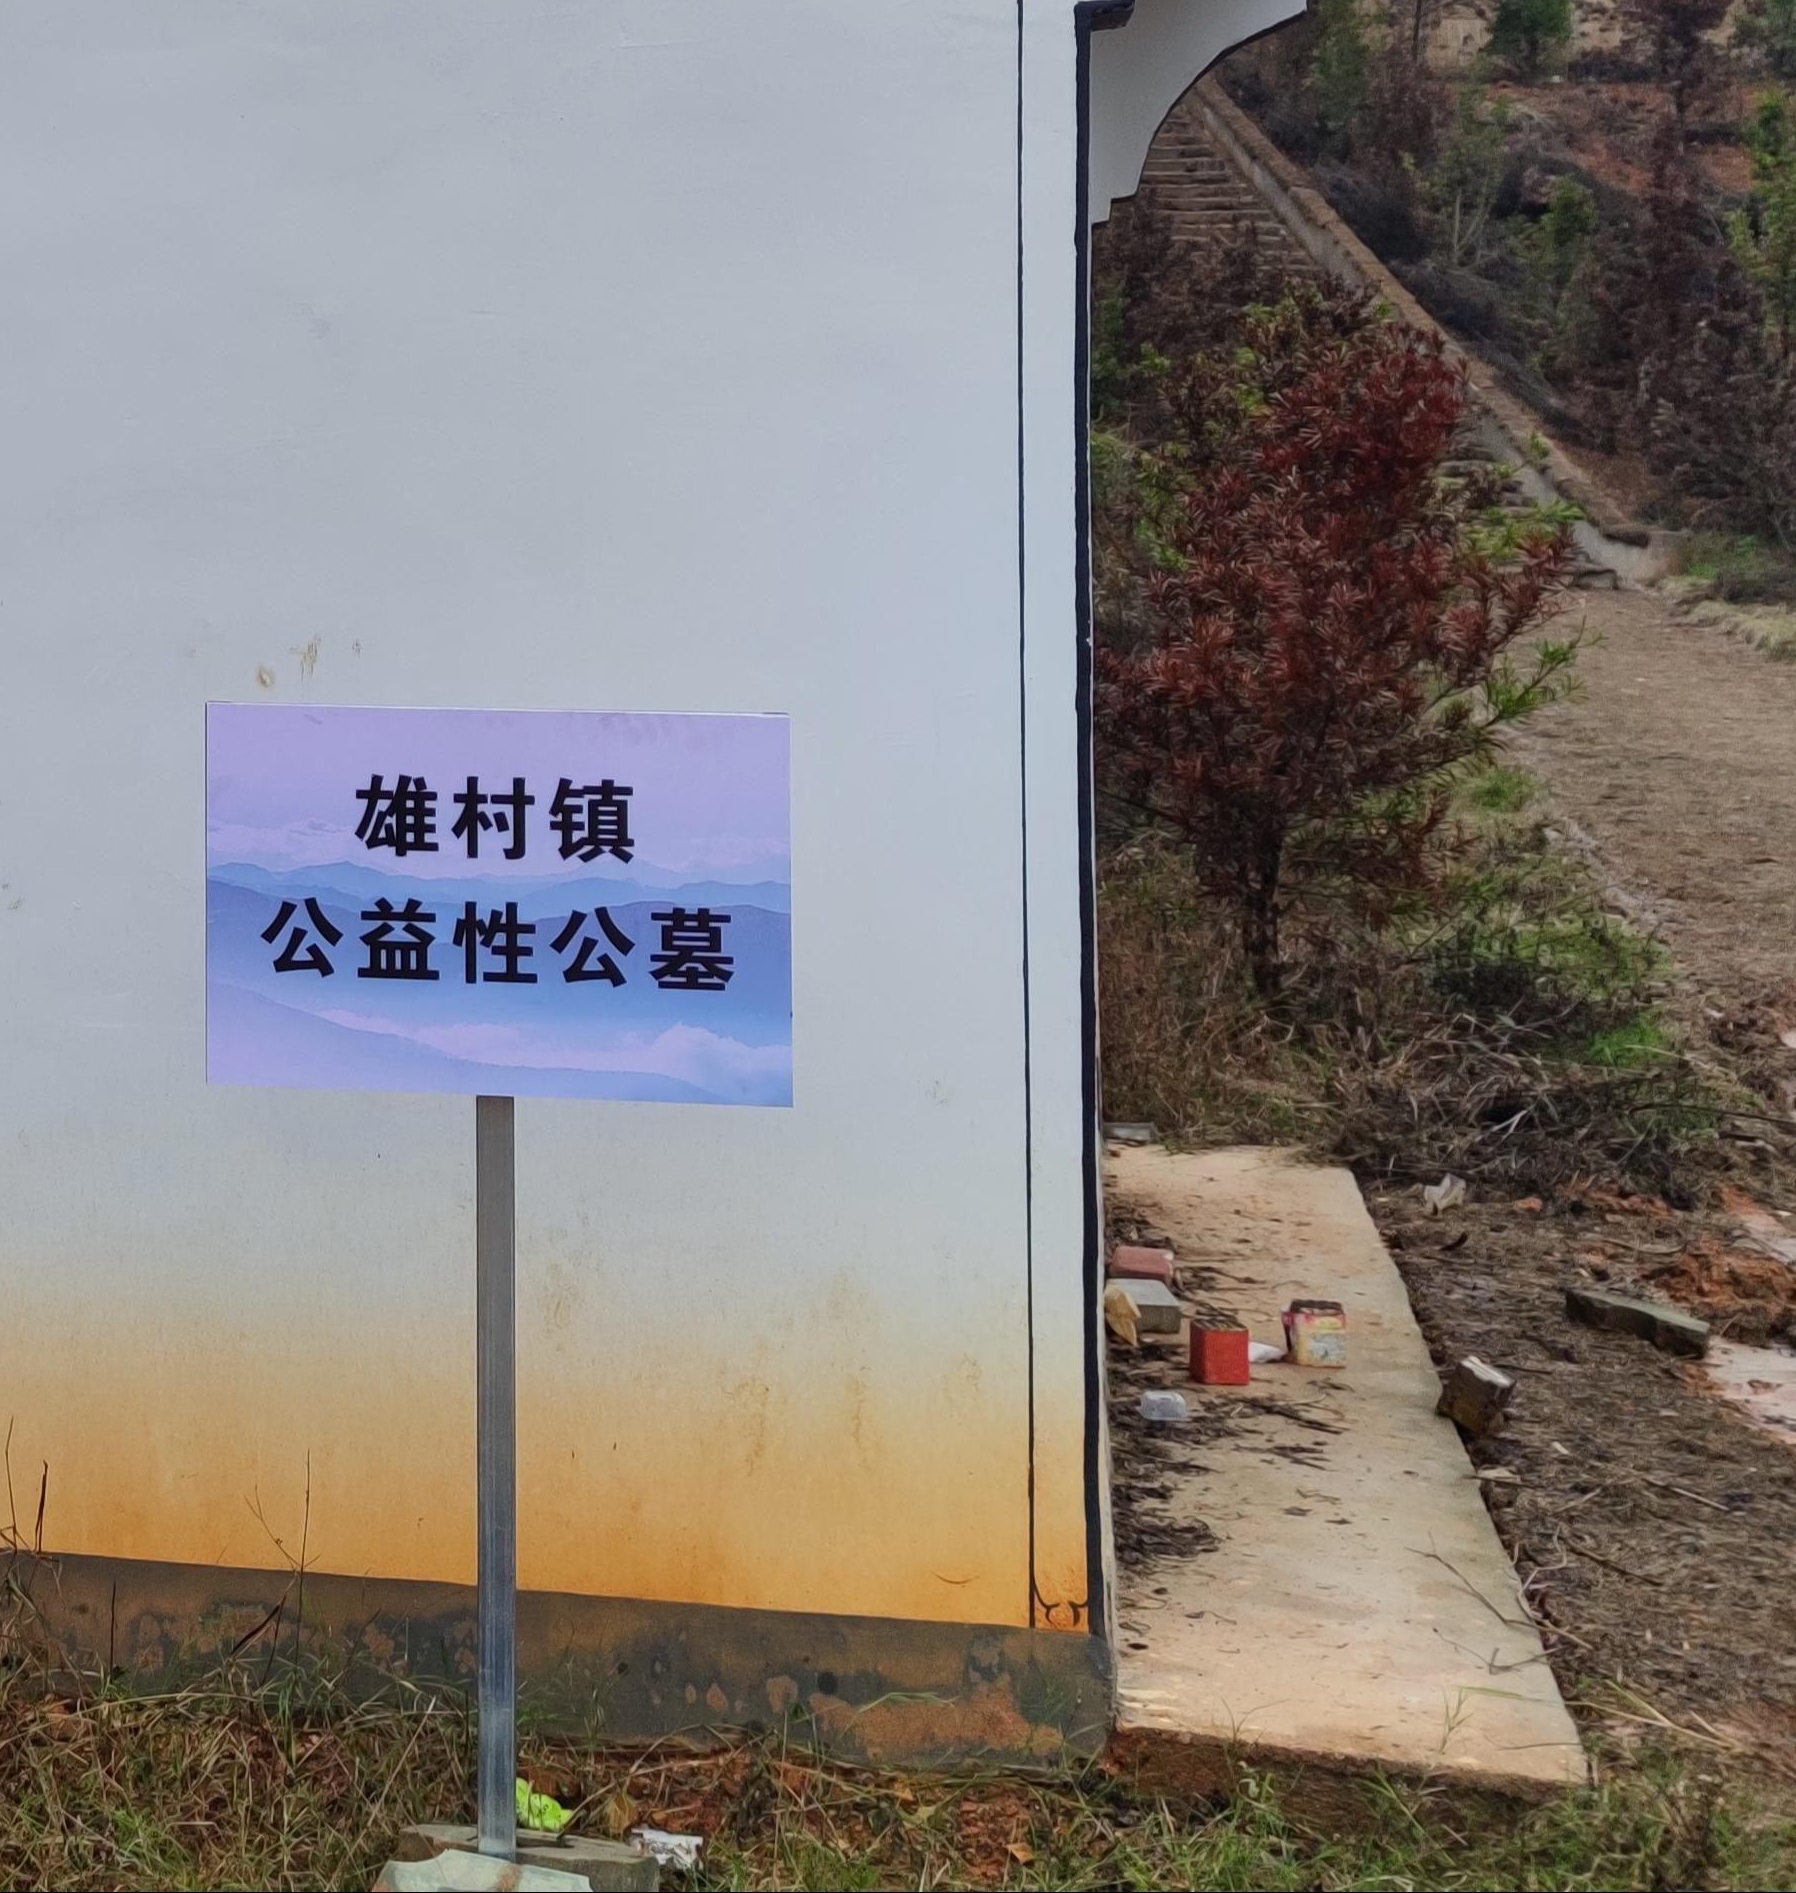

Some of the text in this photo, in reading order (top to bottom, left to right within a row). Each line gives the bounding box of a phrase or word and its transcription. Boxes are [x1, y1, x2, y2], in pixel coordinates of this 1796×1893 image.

[354, 774, 635, 864] 雄村镇
[261, 897, 735, 991] 公益性公墓
